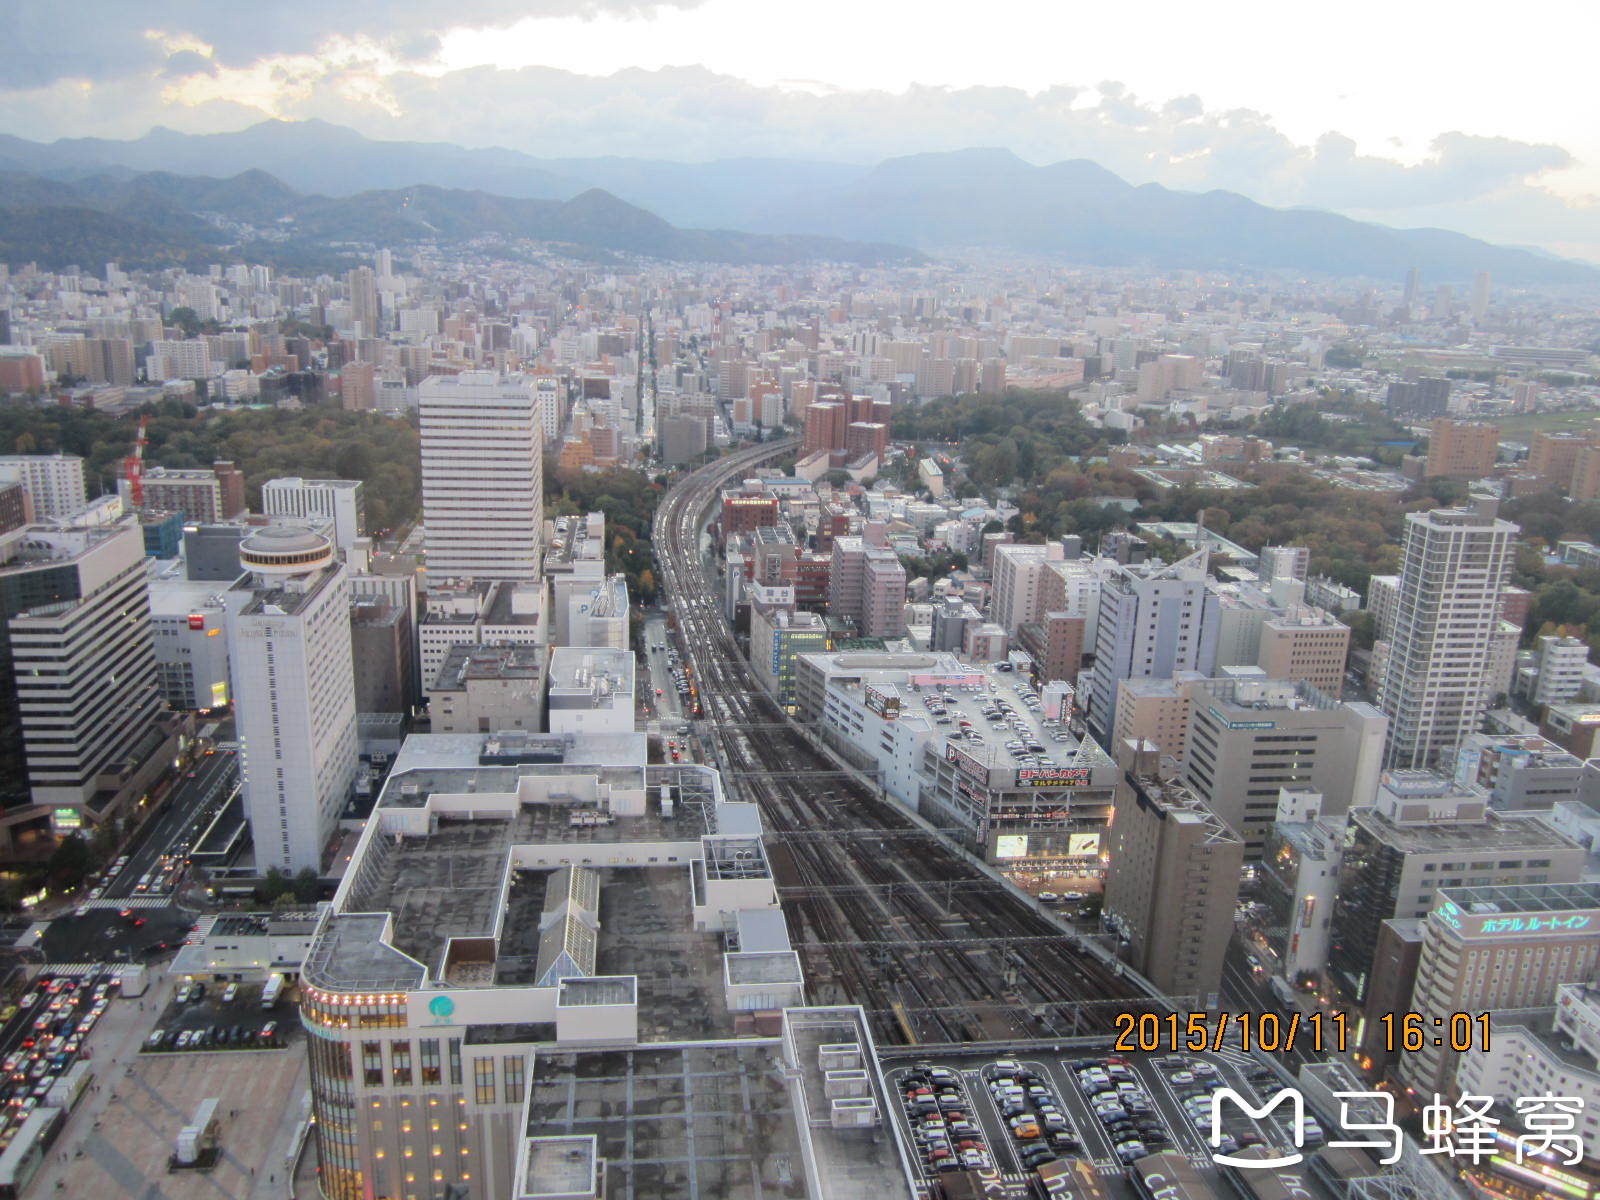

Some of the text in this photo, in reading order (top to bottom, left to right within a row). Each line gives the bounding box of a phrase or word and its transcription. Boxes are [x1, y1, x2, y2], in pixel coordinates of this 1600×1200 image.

[1019, 768, 1089, 779] ヨドバシカメラ
[1481, 914, 1591, 933] ホテル ルートイン
